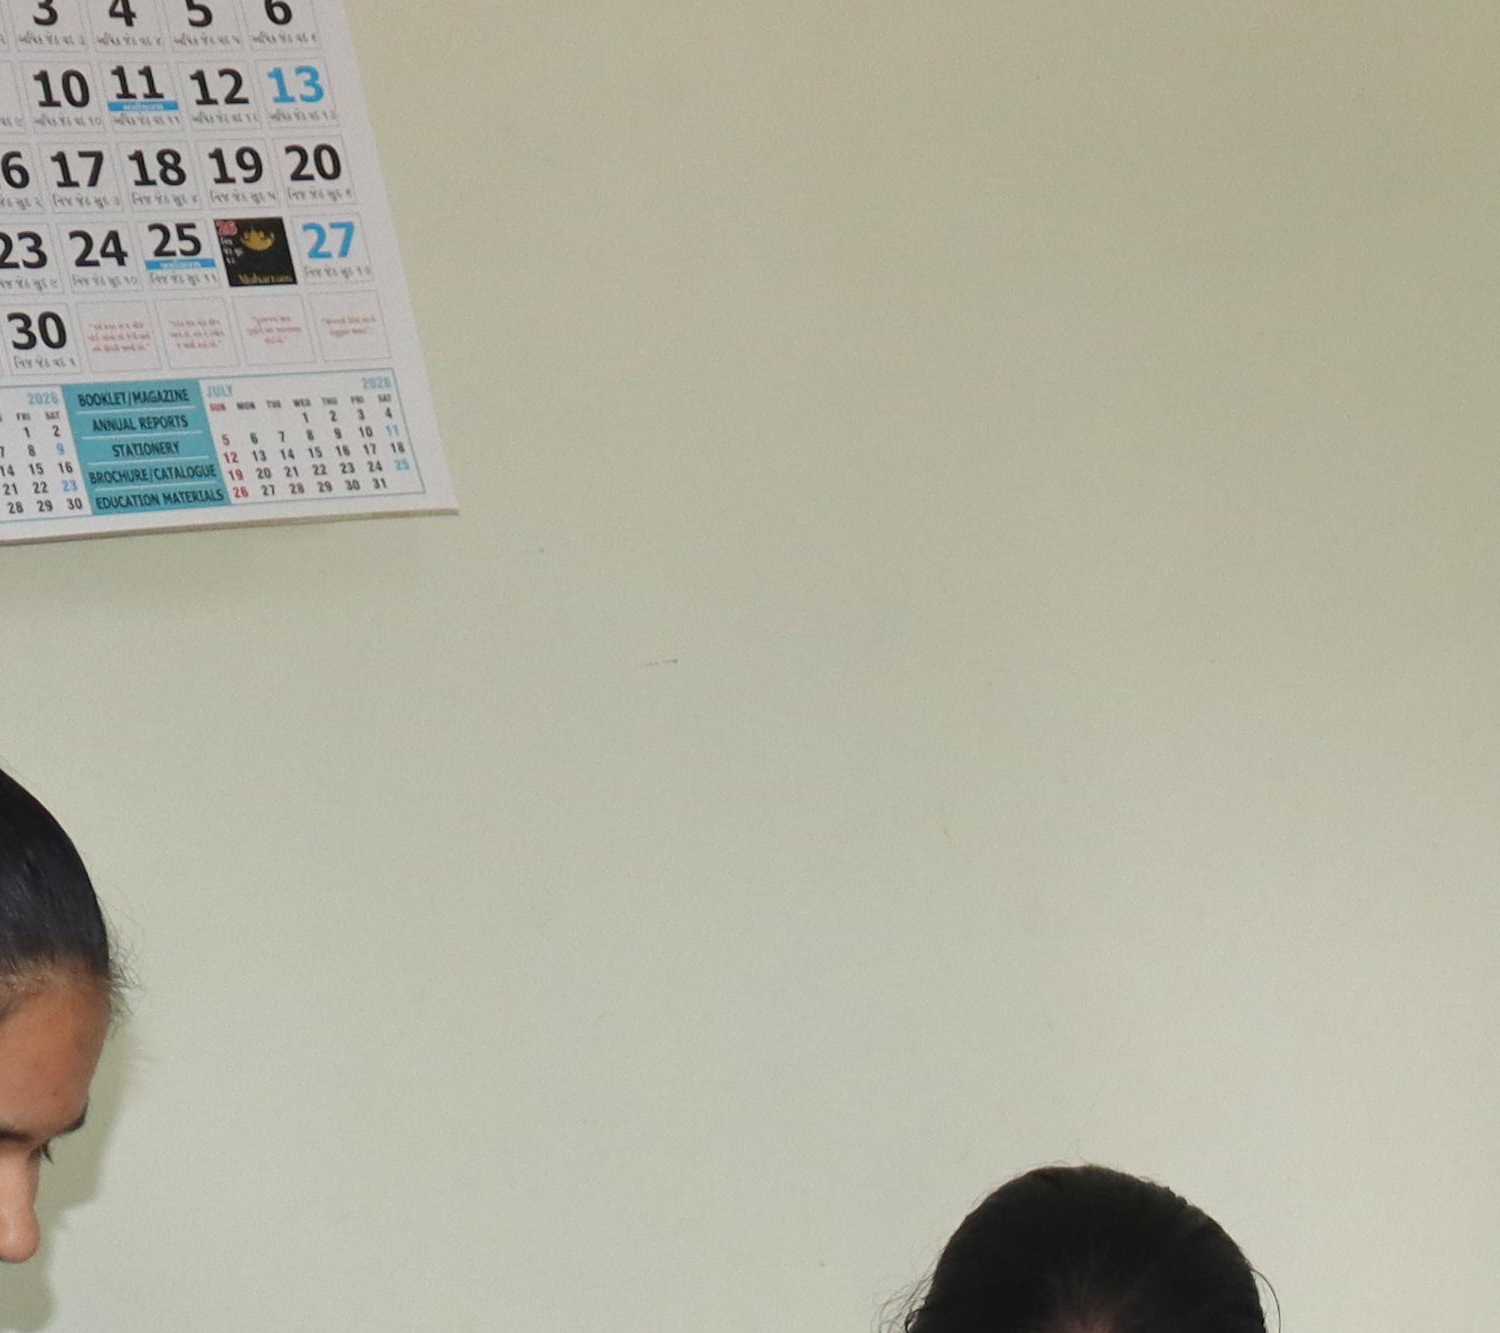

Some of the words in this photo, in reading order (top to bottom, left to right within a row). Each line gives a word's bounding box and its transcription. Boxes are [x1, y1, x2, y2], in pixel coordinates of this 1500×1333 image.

[30, 0, 58, 26] 3
[109, 0, 137, 27] 4
[187, 0, 213, 27] 5
[264, 0, 293, 25] 6
[33, 69, 90, 108] 10
[111, 65, 164, 99] 11
[189, 68, 249, 105] 12
[267, 66, 325, 104] 13
[50, 151, 104, 188] 17
[128, 149, 187, 186] 18
[208, 147, 264, 183] 19
[284, 144, 341, 181] 20
[69, 230, 128, 267] 24
[148, 223, 202, 257] 25
[302, 221, 355, 260] 27
[7, 311, 67, 350] 30
[207, 385, 233, 397] JULY
[363, 377, 392, 389] 2026
[28, 393, 59, 404] 2026
[78, 389, 189, 407] BOOKLET/MAGAZINE
[93, 418, 136, 432] ANNUAL
[139, 415, 188, 429] REPORTS
[302, 412, 308, 422] 1
[330, 411, 337, 421] 2
[357, 410, 365, 420] 3
[385, 408, 392, 418] 4
[24, 427, 30, 437] 1
[52, 426, 60, 437] 2
[222, 434, 230, 446] 5
[250, 433, 258, 444] 6
[279, 432, 285, 443] 7
[307, 430, 314, 441] 8
[334, 429, 341, 439] 9
[359, 427, 373, 437] 10
[387, 425, 399, 436] 11
[28, 445, 36, 456] 8
[57, 443, 65, 455] 9
[112, 441, 180, 457] STATIONERY
[224, 452, 239, 463] 12
[253, 451, 267, 461] 13
[281, 449, 295, 460] 14
[309, 447, 322, 458] 15
[336, 446, 350, 456] 16
[364, 444, 377, 455] 17
[391, 443, 404, 453] 18
[0, 465, 15, 477] 14
[29, 463, 44, 475] 15
[58, 462, 73, 474] 16
[88, 465, 216, 484] BROCHURE/CATALOGUE
[229, 470, 243, 481] 19
[257, 468, 271, 479] 20
[285, 466, 299, 477] 21
[312, 464, 327, 475] 22
[340, 463, 355, 474] 23
[369, 461, 383, 472] 24
[395, 459, 410, 471] 25
[4, 483, 18, 495] 21
[33, 482, 48, 494] 22
[62, 480, 77, 492] 23
[233, 487, 249, 498] 26
[261, 485, 275, 496] 27
[290, 483, 305, 494] 28
[318, 481, 332, 492] 29
[346, 480, 360, 490] 30
[373, 478, 387, 489] 31
[9, 502, 23, 514] 28
[37, 501, 52, 512] 29
[67, 498, 82, 510] 30
[96, 494, 158, 510] EDUCATION
[163, 489, 224, 505] MATERIALS
